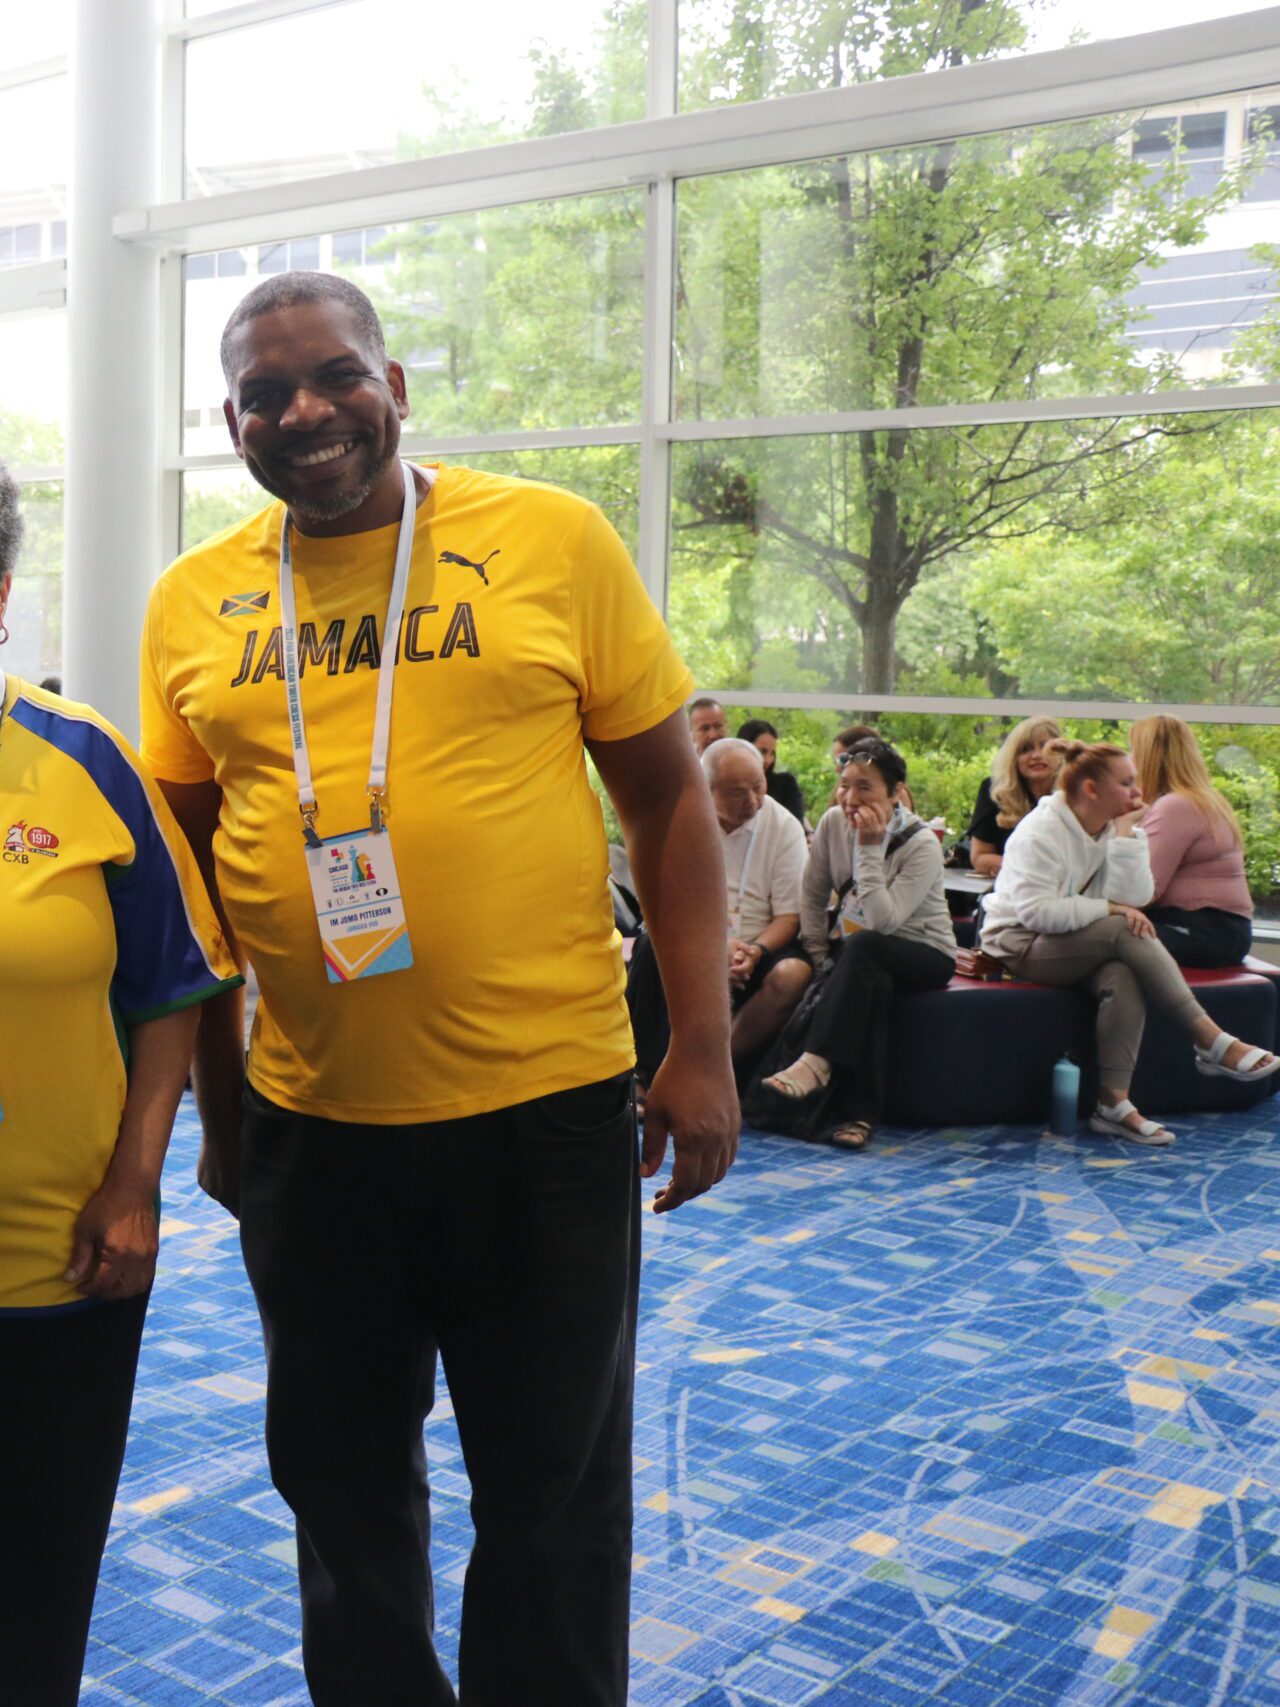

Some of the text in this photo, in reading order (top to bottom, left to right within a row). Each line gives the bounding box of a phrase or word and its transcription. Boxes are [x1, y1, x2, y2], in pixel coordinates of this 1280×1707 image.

[32, 832, 51, 846] 1917
[3, 852, 29, 864] CXB
[330, 906, 391, 926] IM JOMO PITTERSON
